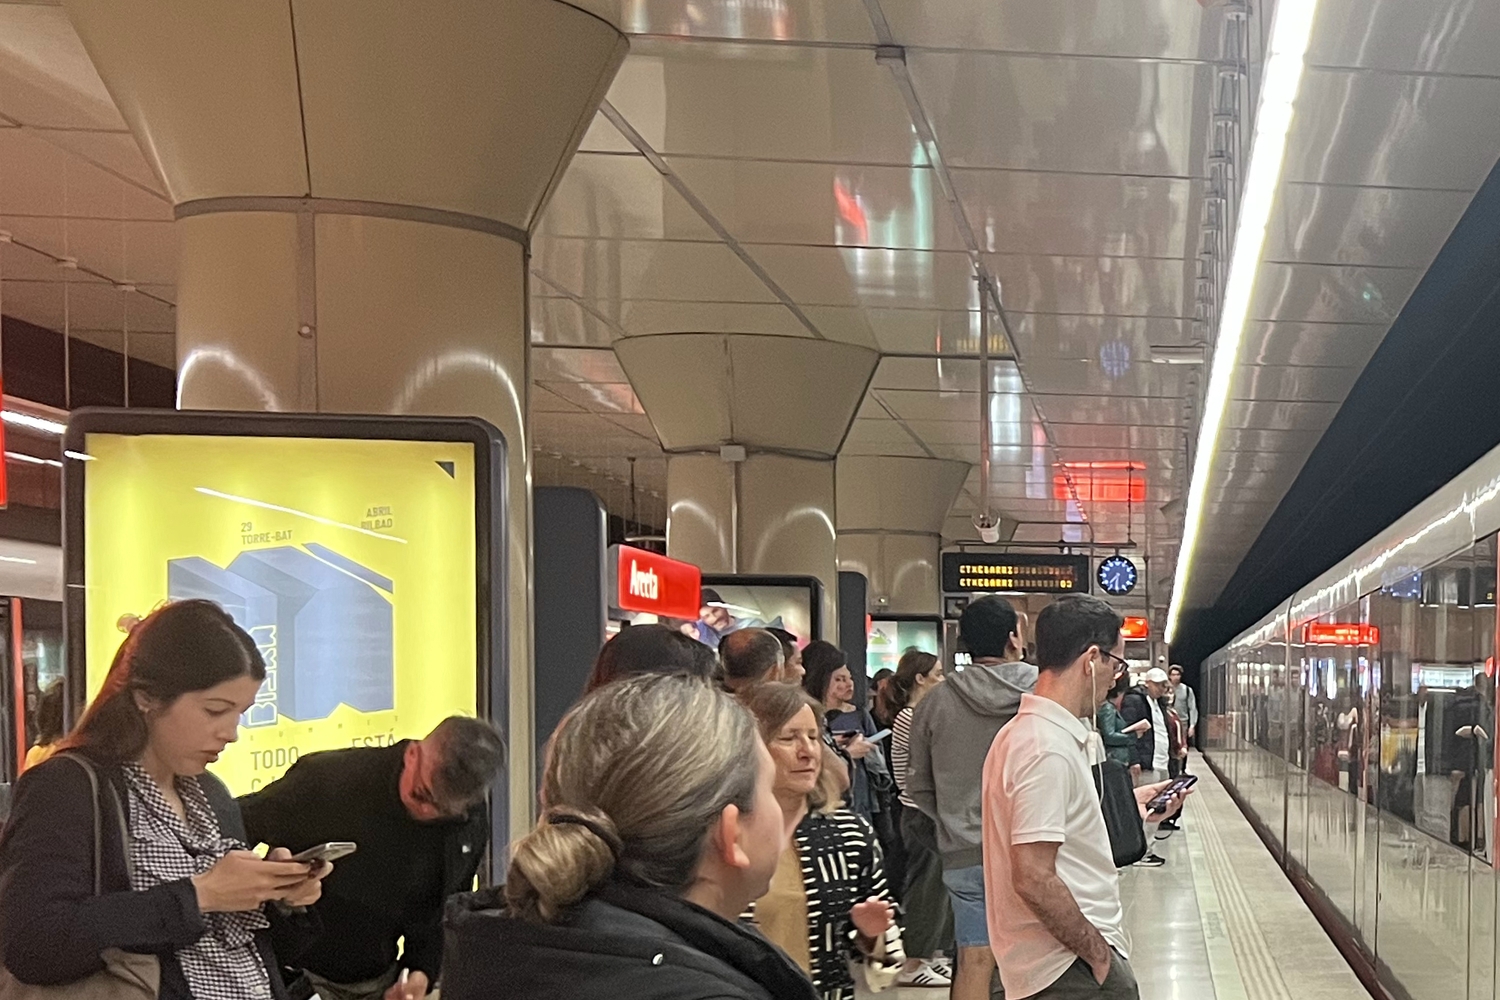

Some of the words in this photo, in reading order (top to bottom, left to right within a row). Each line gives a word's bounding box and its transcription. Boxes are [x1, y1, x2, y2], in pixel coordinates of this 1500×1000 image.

[366, 506, 393, 518] ABRIL
[241, 522, 253, 533] 29
[360, 518, 393, 531] BILBAO
[241, 530, 293, 545] TORRE-BAT
[250, 746, 299, 771] TODO
